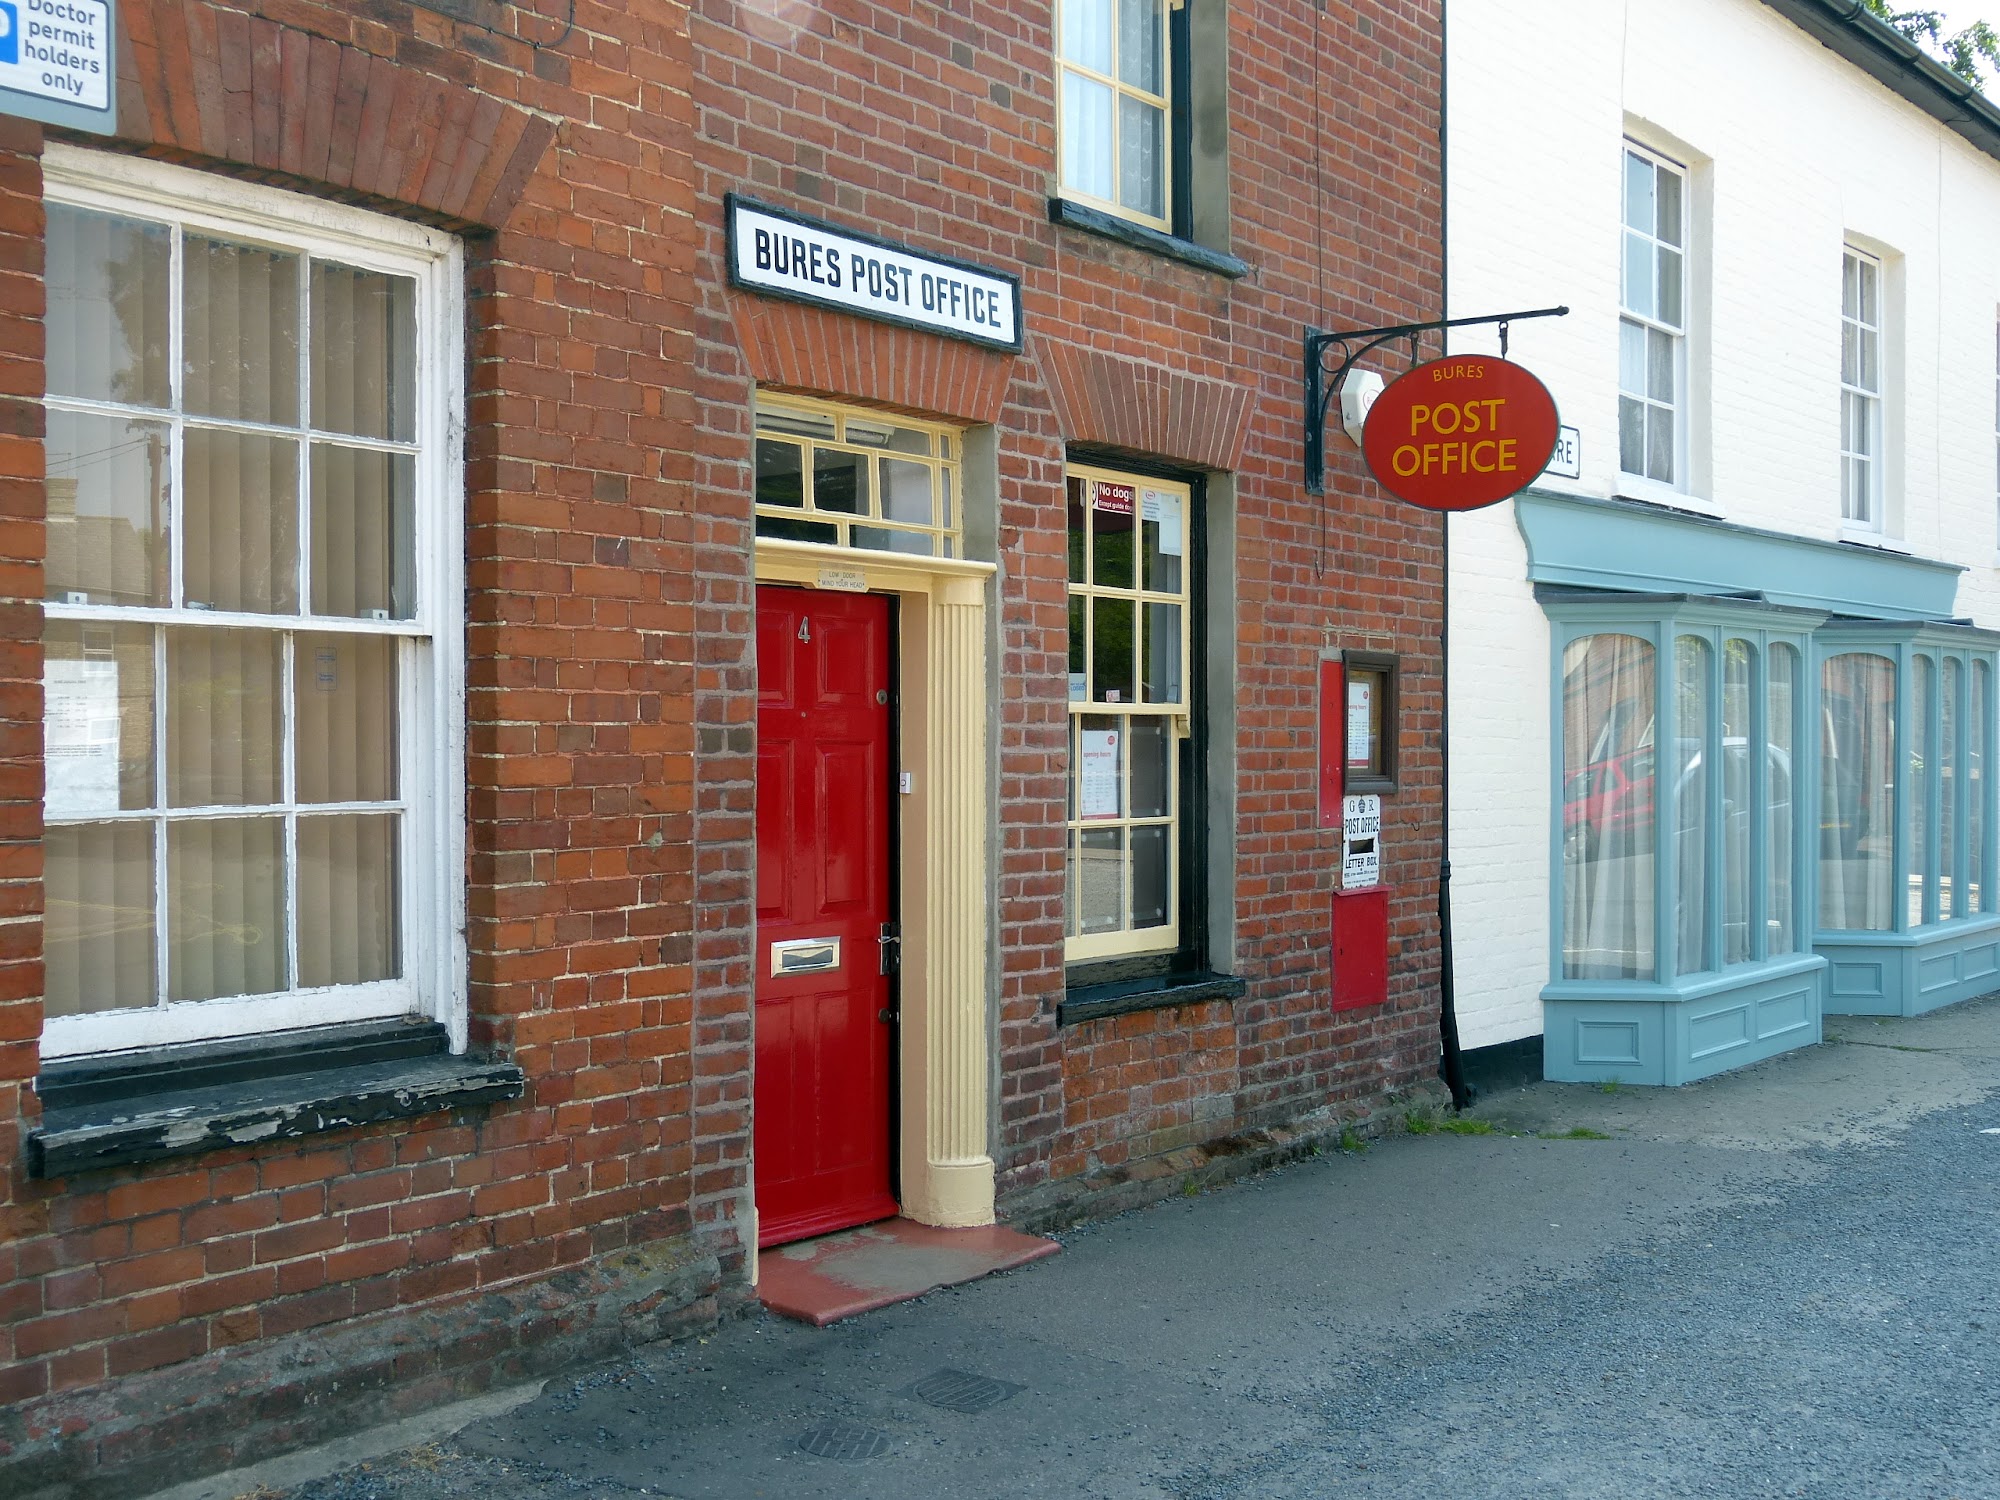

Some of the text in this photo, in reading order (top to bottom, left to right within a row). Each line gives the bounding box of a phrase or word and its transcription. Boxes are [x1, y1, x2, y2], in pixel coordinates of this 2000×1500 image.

[28, 0, 96, 26] Doctor
[29, 21, 95, 50] permit
[25, 39, 100, 74] holders
[42, 72, 84, 96] only
[755, 228, 1002, 328] BURES POST OFFICE
[1433, 365, 1484, 382] BURES
[1411, 398, 1506, 437] POST
[1392, 438, 1517, 477] OFFICE
[1553, 438, 1573, 465] RE
[1099, 483, 1111, 496] No
[1113, 486, 1133, 502] dogs
[821, 579, 863, 589] MIND YOUR HEAD
[797, 615, 811, 644] 4
[1083, 751, 1099, 759] opening
[1349, 799, 1374, 813] G R
[1345, 816, 1379, 835] POST OFFICE
[1345, 857, 1365, 869] LETTER
